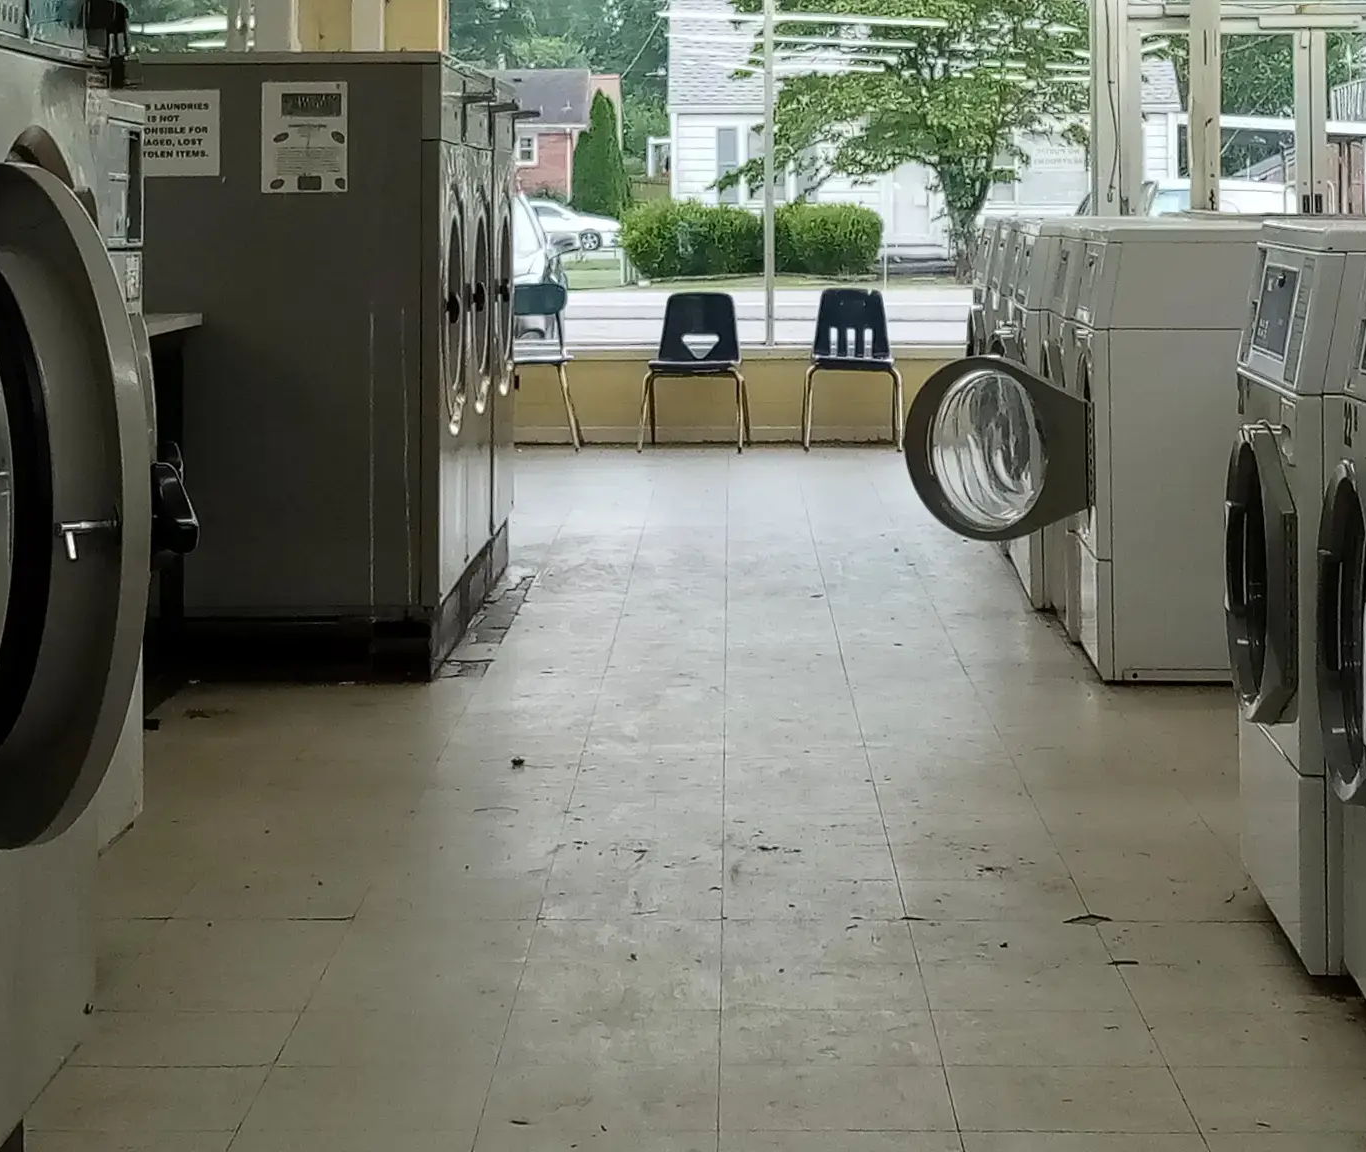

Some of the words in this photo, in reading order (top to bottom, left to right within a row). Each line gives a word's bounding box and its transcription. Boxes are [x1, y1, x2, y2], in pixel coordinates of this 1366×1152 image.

[154, 102, 210, 112] LAUNDRIES
[147, 115, 157, 124] IS
[159, 114, 180, 123] NOT
[144, 126, 186, 135] ONSIBLE
[189, 126, 209, 135] FOR
[143, 138, 176, 148] AGED,
[177, 138, 203, 147] LOST
[143, 150, 174, 159] TOLEN
[176, 149, 210, 159] ITEMS.
